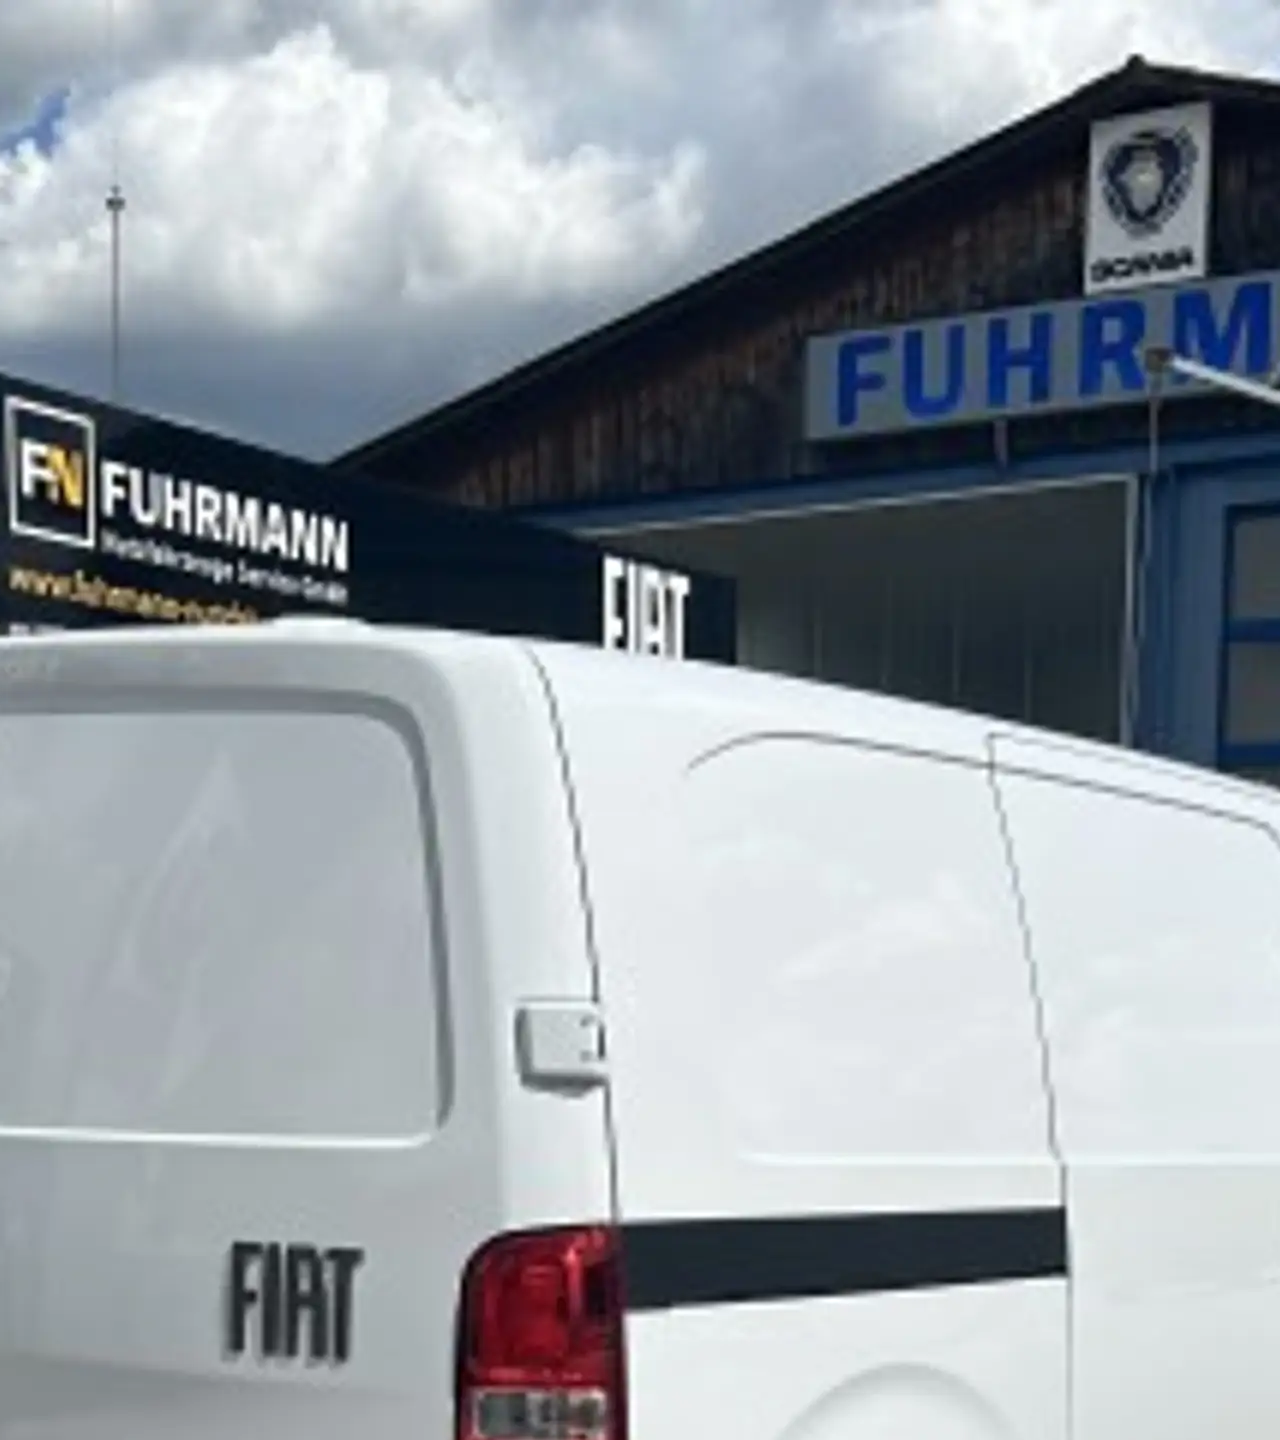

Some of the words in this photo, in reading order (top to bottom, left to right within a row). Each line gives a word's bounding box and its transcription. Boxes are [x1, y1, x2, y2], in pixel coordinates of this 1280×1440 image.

[1091, 246, 1194, 283] SCANIA
[100, 457, 348, 572] FUHRMANN
[603, 556, 690, 661] FIAT
[226, 1241, 363, 1365] FIAT
